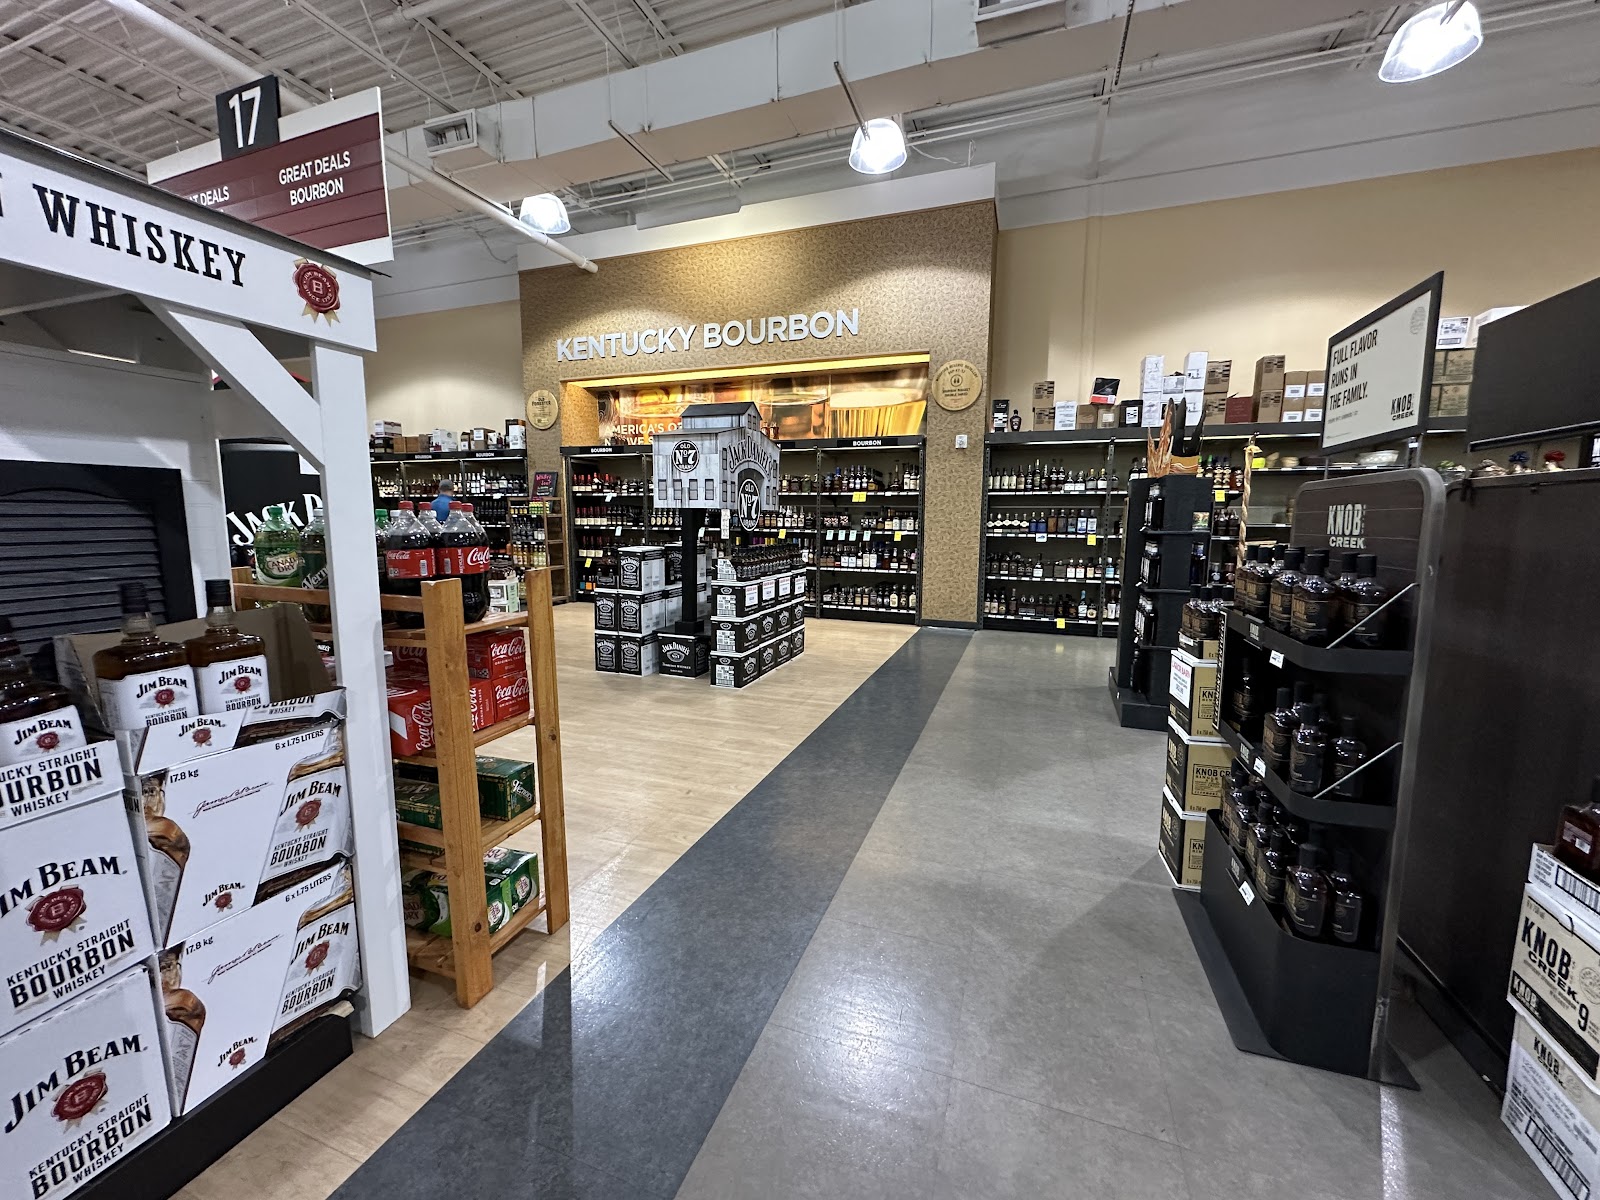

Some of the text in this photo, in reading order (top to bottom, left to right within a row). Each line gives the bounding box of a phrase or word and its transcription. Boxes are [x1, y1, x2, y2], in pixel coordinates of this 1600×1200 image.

[228, 86, 262, 149] 17
[278, 151, 351, 185] GREAT DEALS
[200, 186, 230, 206] DEALS
[290, 177, 344, 206] BOURBON
[32, 183, 247, 288] WHISKEY
[557, 308, 859, 362] KENTUCKY BOURBON
[1333, 329, 1378, 367] FULL FLAVOR
[1331, 362, 1358, 389] RUNS IN
[1329, 381, 1368, 411] THE FAMILY.
[1391, 393, 1413, 415] KNOB
[604, 423, 665, 435] AMERICA'S
[1392, 409, 1414, 421] CREEK
[745, 483, 755, 492] OLD
[1327, 503, 1363, 535] KNOB
[1329, 536, 1365, 549] CREEK
[277, 564, 296, 574] DRY
[302, 567, 328, 589] Vern
[136, 676, 188, 698] JIM BEAM
[218, 665, 262, 684] JIM BEAM
[146, 710, 188, 728] BOURBON
[225, 698, 261, 712] BOURBON
[14, 719, 72, 745] JIM BEAM
[179, 718, 222, 737] JIM BEAM
[287, 737, 300, 747] 1.75
[301, 729, 324, 742] LITERS
[0, 747, 97, 783] UCKY STRAIGHT
[169, 768, 199, 784] 17.8 kg
[1195, 767, 1218, 777] KNOB
[0, 758, 102, 808] URBON
[11, 790, 69, 817] WHISKEY
[280, 780, 342, 817] JIM BEAM
[270, 835, 327, 866] BOURBON
[274, 828, 329, 851] KENTUCKY STRAIGHT
[283, 855, 308, 868] WHISKEY
[0, 878, 35, 918] IM
[37, 856, 121, 890] BEAM
[202, 881, 241, 906] JIM BEAM
[296, 885, 309, 897] 1.75
[310, 873, 332, 889] LITERS
[6, 918, 130, 987] KENTUCKY STRAIGHT
[185, 936, 214, 956] 17.8 kg
[290, 921, 350, 966] JIM BEAM
[1521, 915, 1572, 981] KNOB
[10, 929, 135, 1008] BOURBON
[52, 964, 106, 999] WHISKEY
[284, 967, 337, 1000] KENTUCKY STRAIGHT
[1528, 950, 1578, 1003] CREEK
[281, 974, 335, 1014] BOURBON
[1513, 974, 1537, 1008] KNOB
[1578, 1003, 1589, 1032] 9
[217, 1035, 255, 1067] JIM BEAM
[1533, 1036, 1561, 1075] KNOB
[5, 1069, 61, 1133] JIM
[63, 1034, 142, 1080] BEAM
[1536, 1055, 1566, 1090] CREEK
[28, 1130, 92, 1179] KENTUCKY
[97, 1093, 149, 1134] STRAIGHT
[31, 1103, 152, 1200] BOURBON
[72, 1142, 124, 1184] WHISKEY
